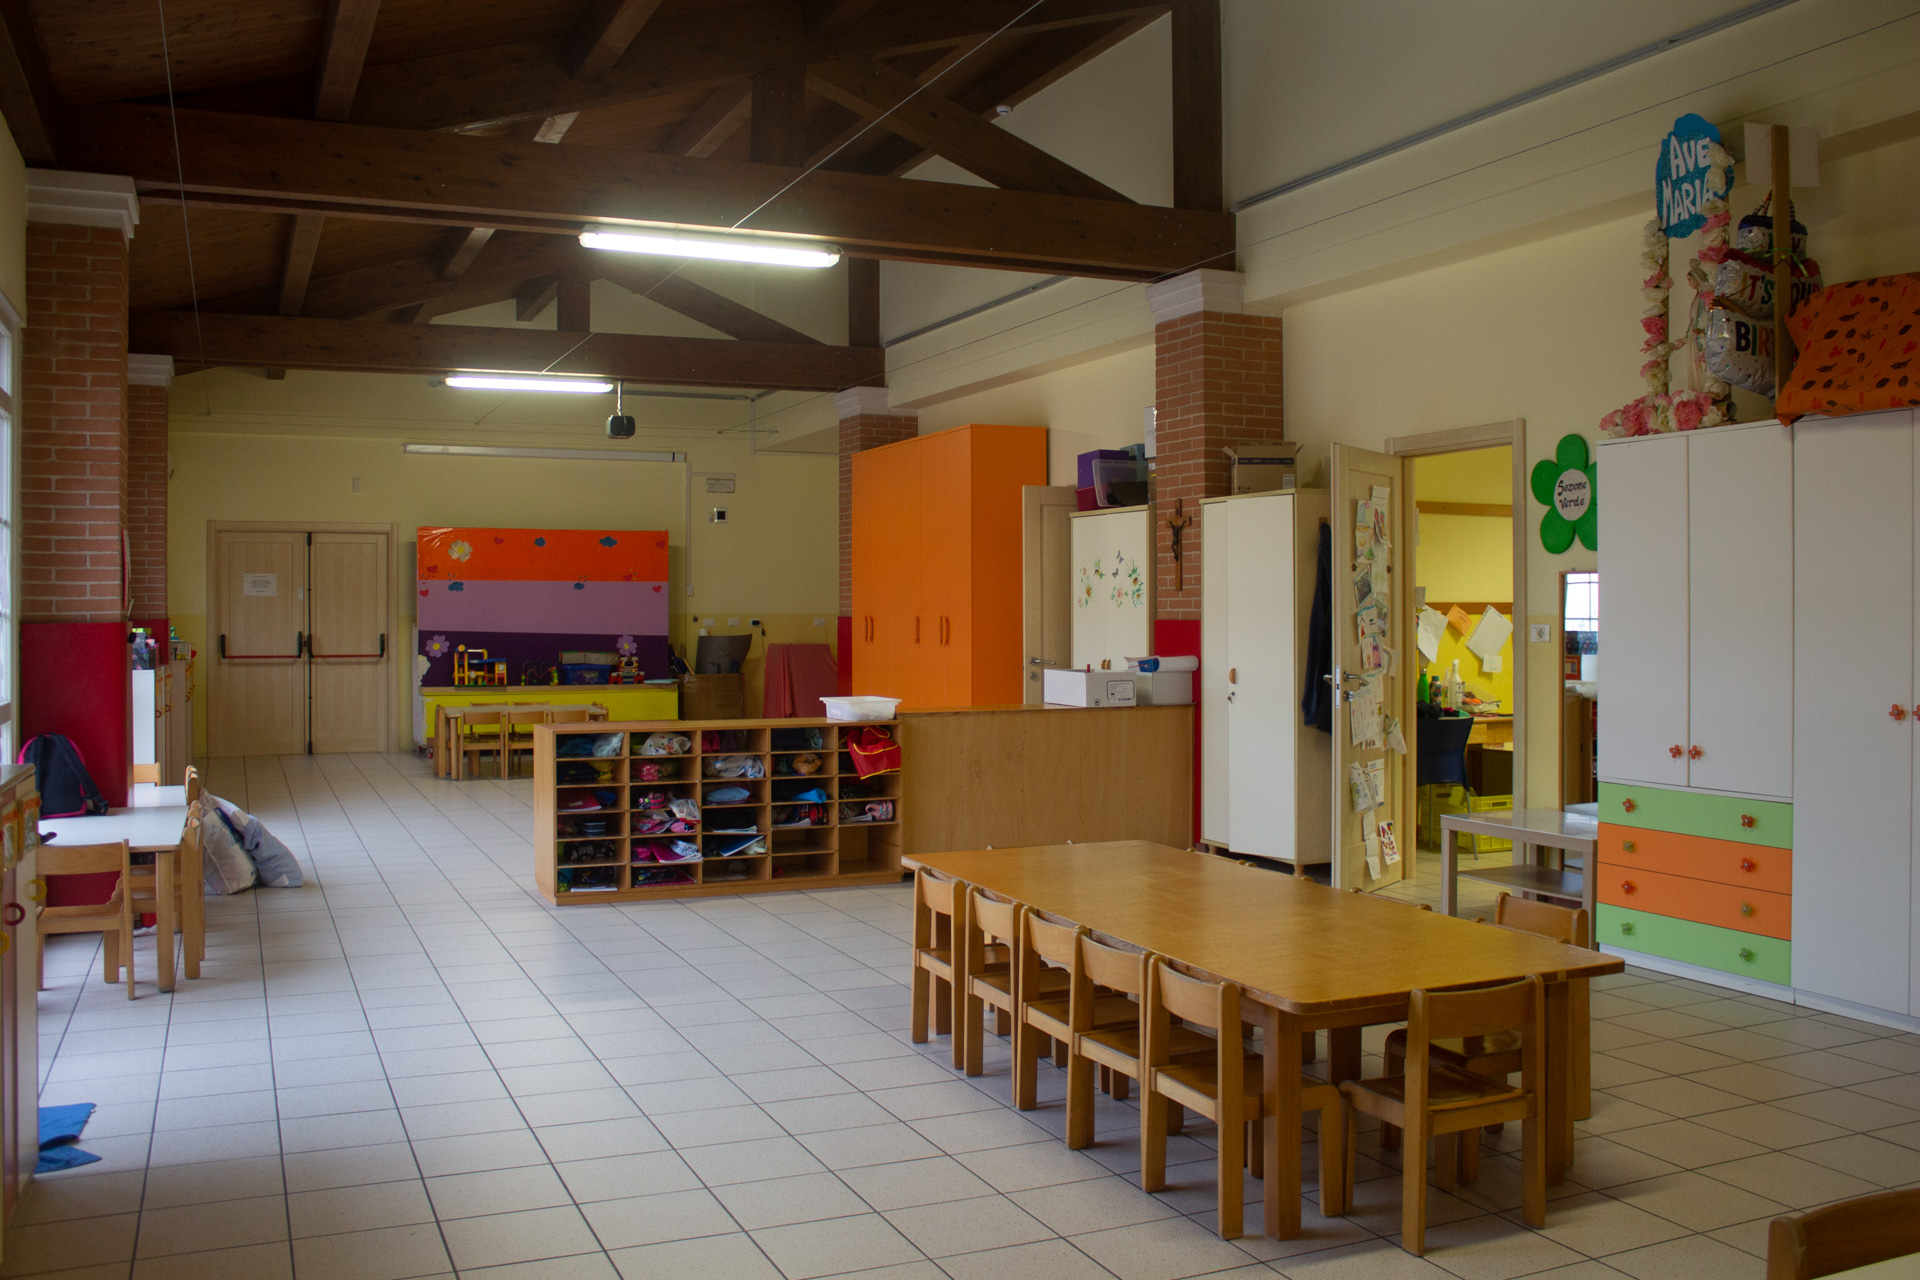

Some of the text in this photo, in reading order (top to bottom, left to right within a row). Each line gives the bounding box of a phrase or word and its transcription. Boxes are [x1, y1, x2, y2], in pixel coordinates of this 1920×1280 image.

[1670, 135, 1711, 180] AVE
[1662, 170, 1713, 229] MARIA
[1739, 272, 1775, 305] IT'S
[1557, 480, 1587, 497] Sezione
[1559, 496, 1585, 509] Verde
